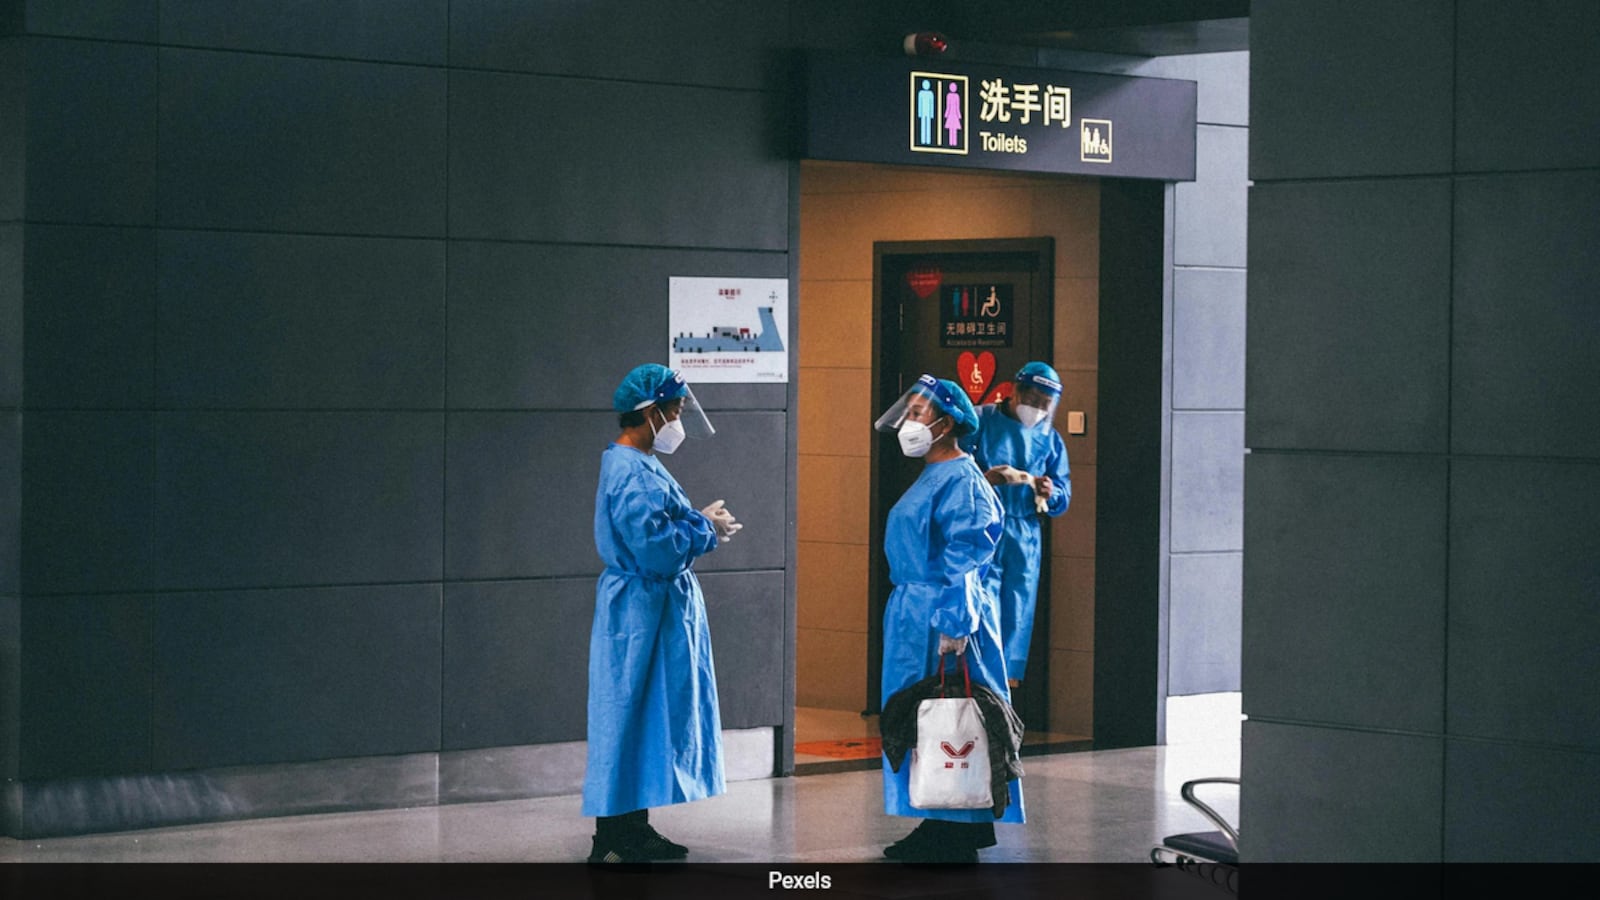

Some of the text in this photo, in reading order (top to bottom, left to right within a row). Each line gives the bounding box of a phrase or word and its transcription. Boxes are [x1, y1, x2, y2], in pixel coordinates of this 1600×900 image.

[979, 78, 1071, 129] 洗手间
[979, 131, 1028, 154] Toilets
[946, 321, 1006, 335] 无障碍卫生间
